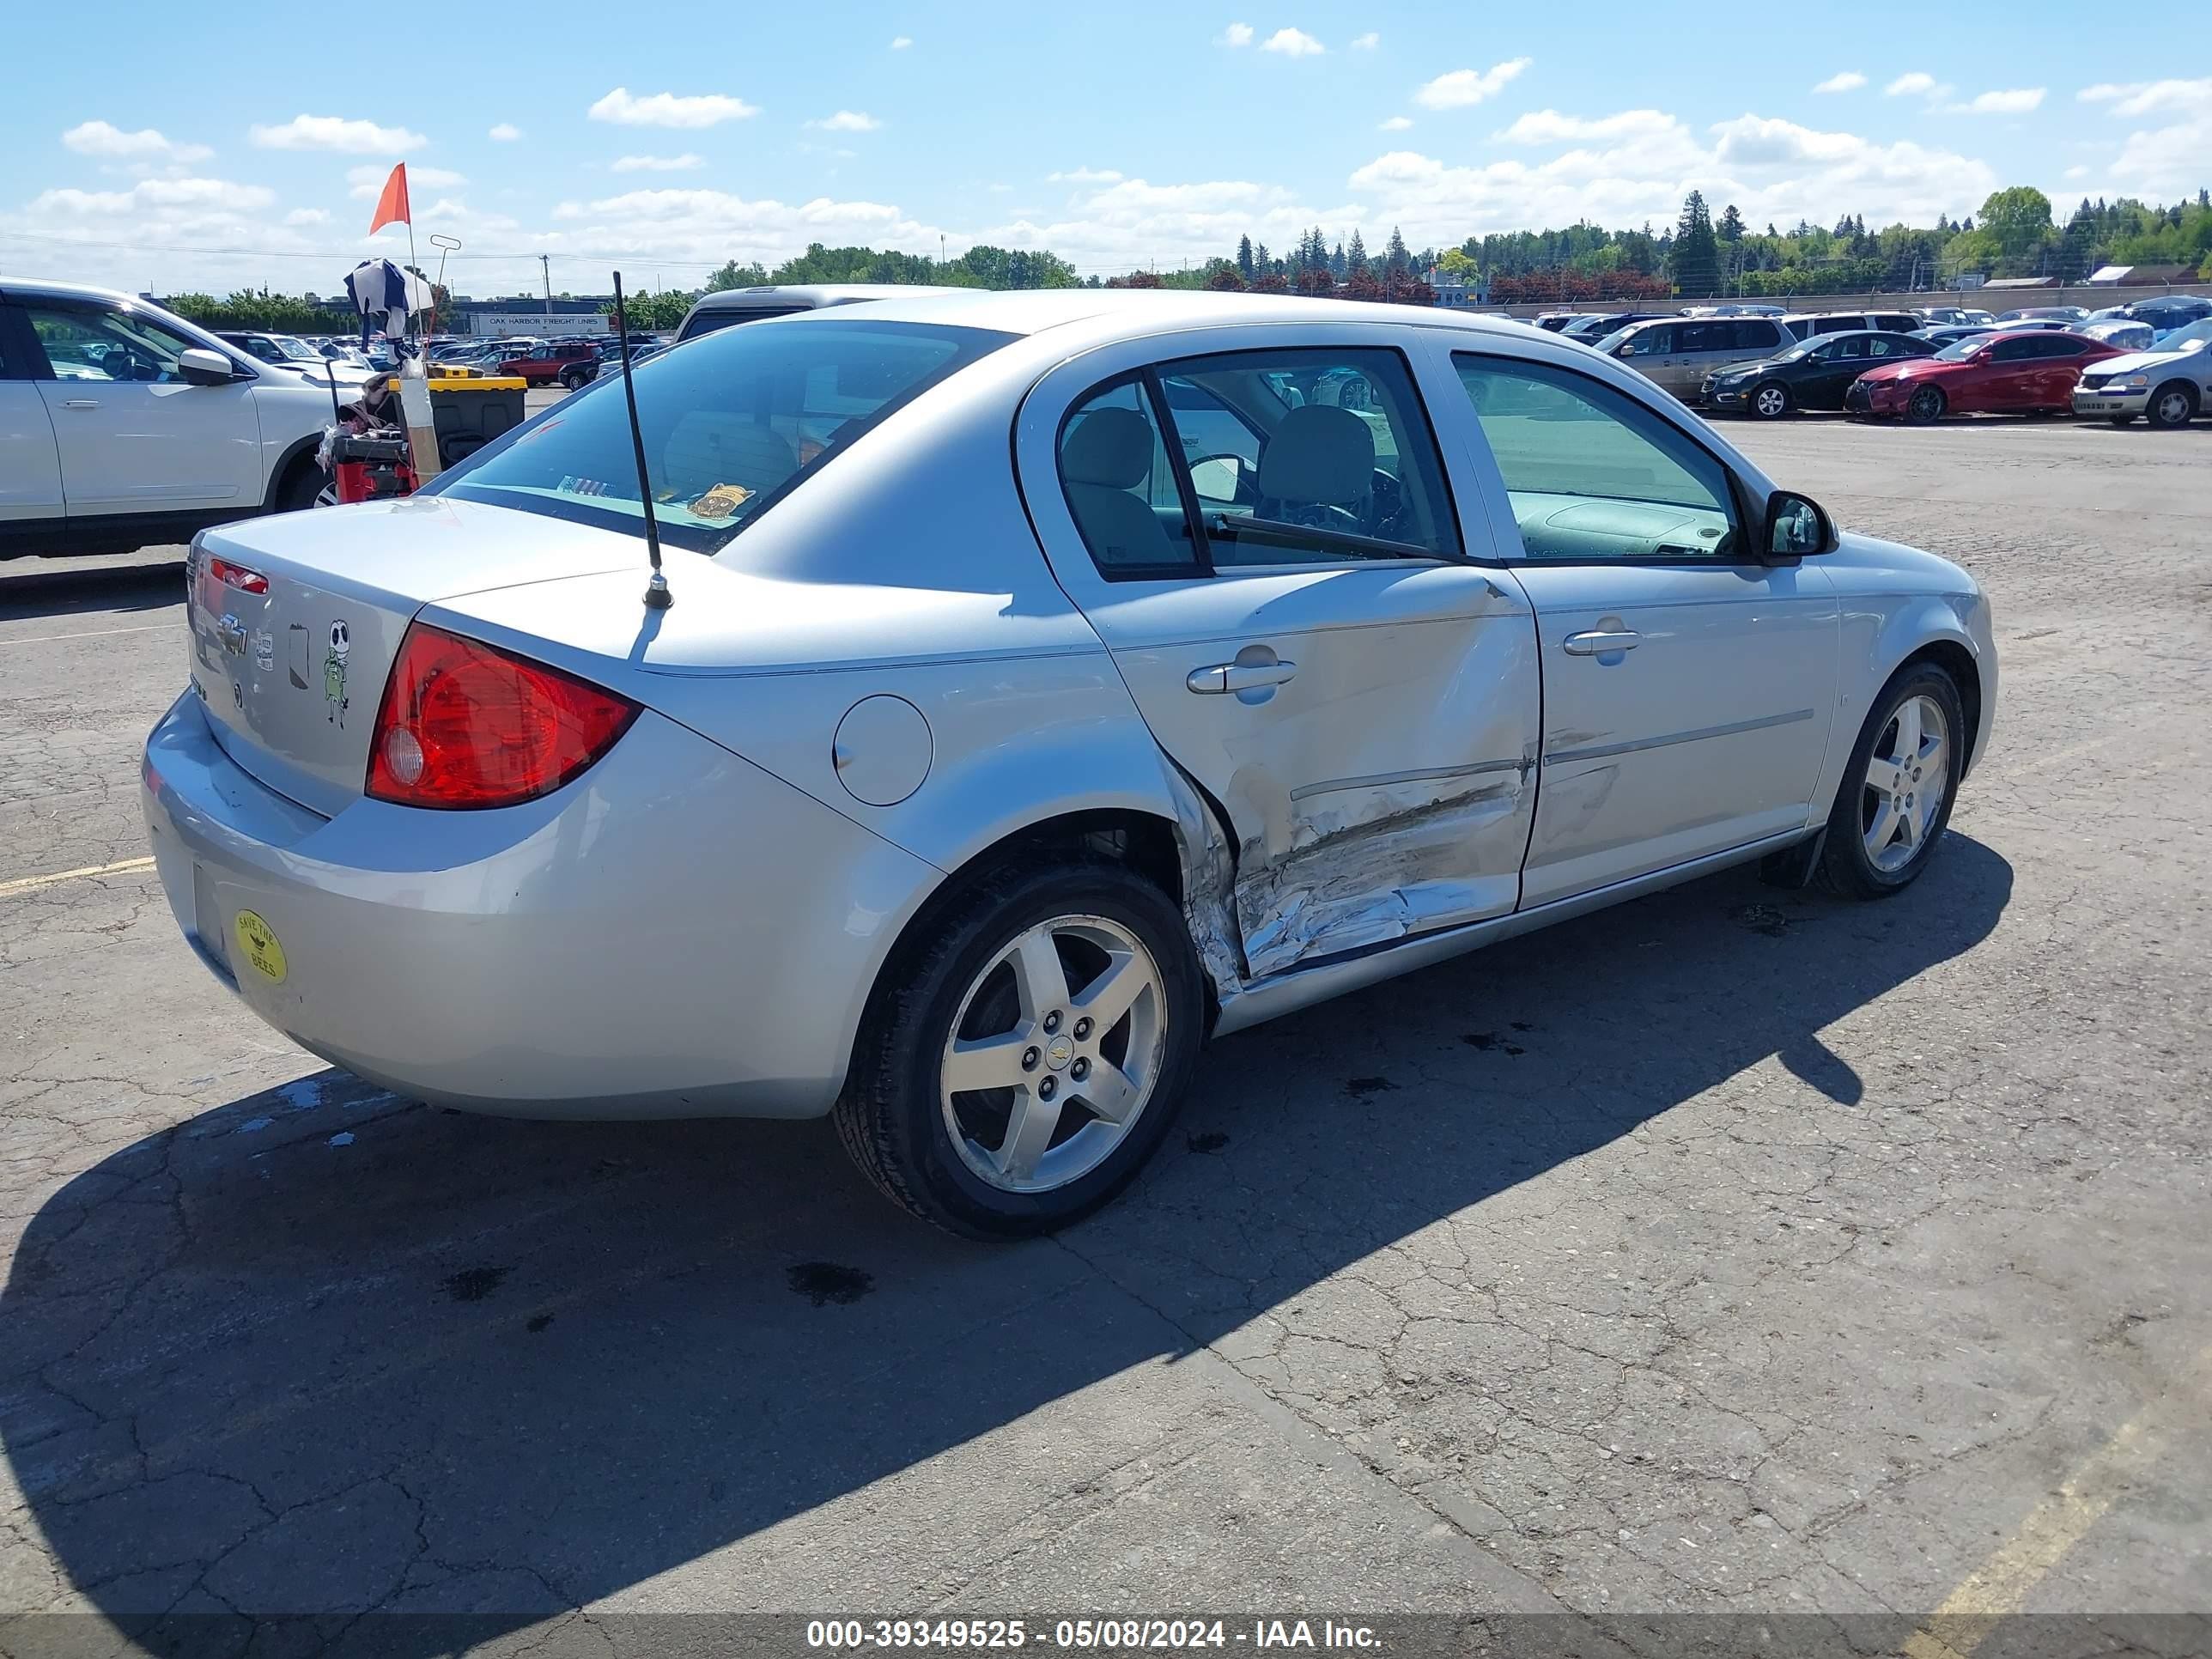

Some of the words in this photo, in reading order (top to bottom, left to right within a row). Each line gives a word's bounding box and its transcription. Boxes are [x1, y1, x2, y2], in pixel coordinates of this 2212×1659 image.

[239, 916, 257, 931] SAVE
[258, 923, 274, 945] THE
[251, 953, 276, 977] BEES
